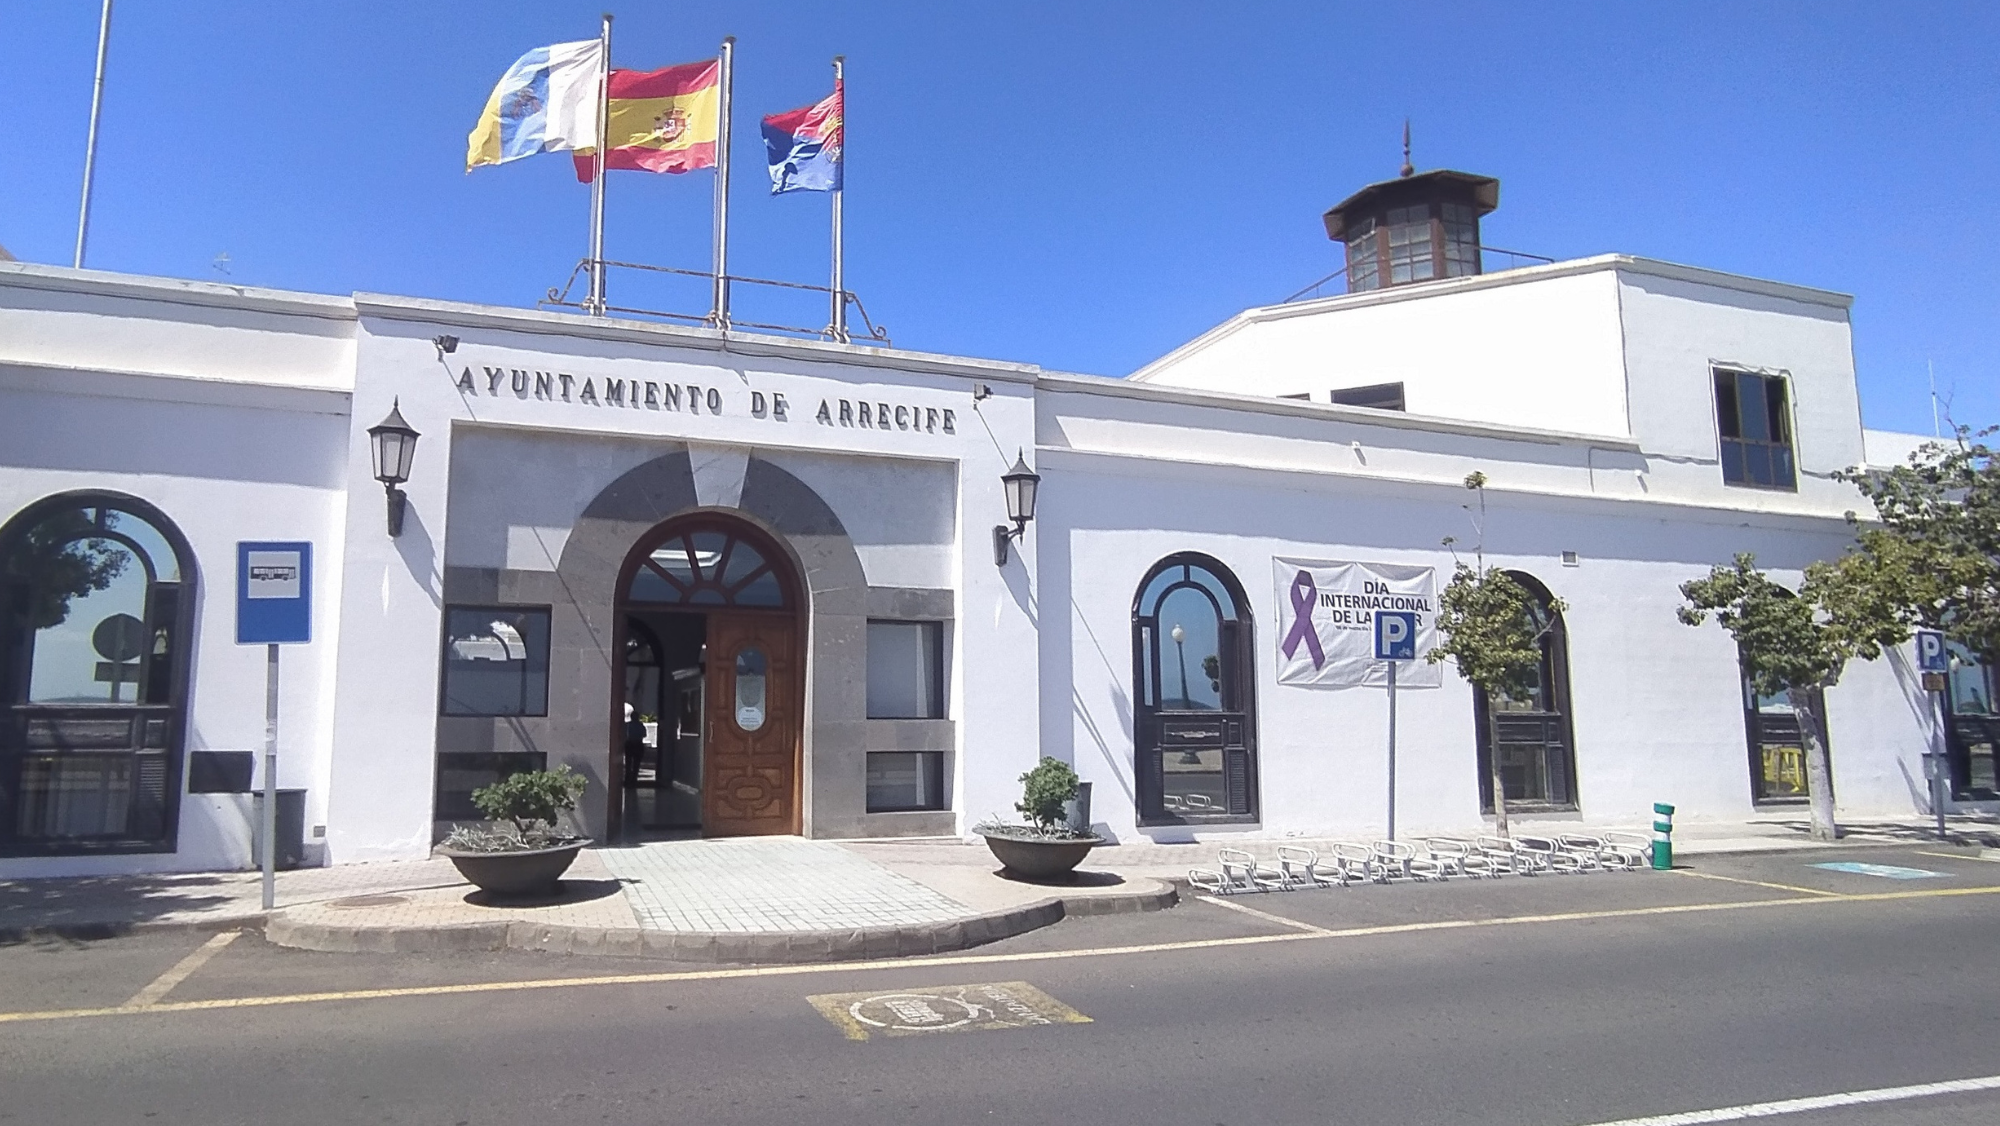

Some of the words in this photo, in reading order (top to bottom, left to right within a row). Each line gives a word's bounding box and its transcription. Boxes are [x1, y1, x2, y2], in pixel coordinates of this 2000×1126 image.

[456, 366, 721, 411] AYUNTAMIENTO
[751, 391, 785, 416] DE
[816, 399, 955, 431] ARRECIFE
[1364, 578, 1389, 595] DÍA
[1321, 594, 1431, 612] INTERNACIONAL
[1332, 610, 1351, 624] DE
[1356, 611, 1372, 624] LA
[1382, 615, 1408, 655] P
[1922, 634, 1940, 667] P
